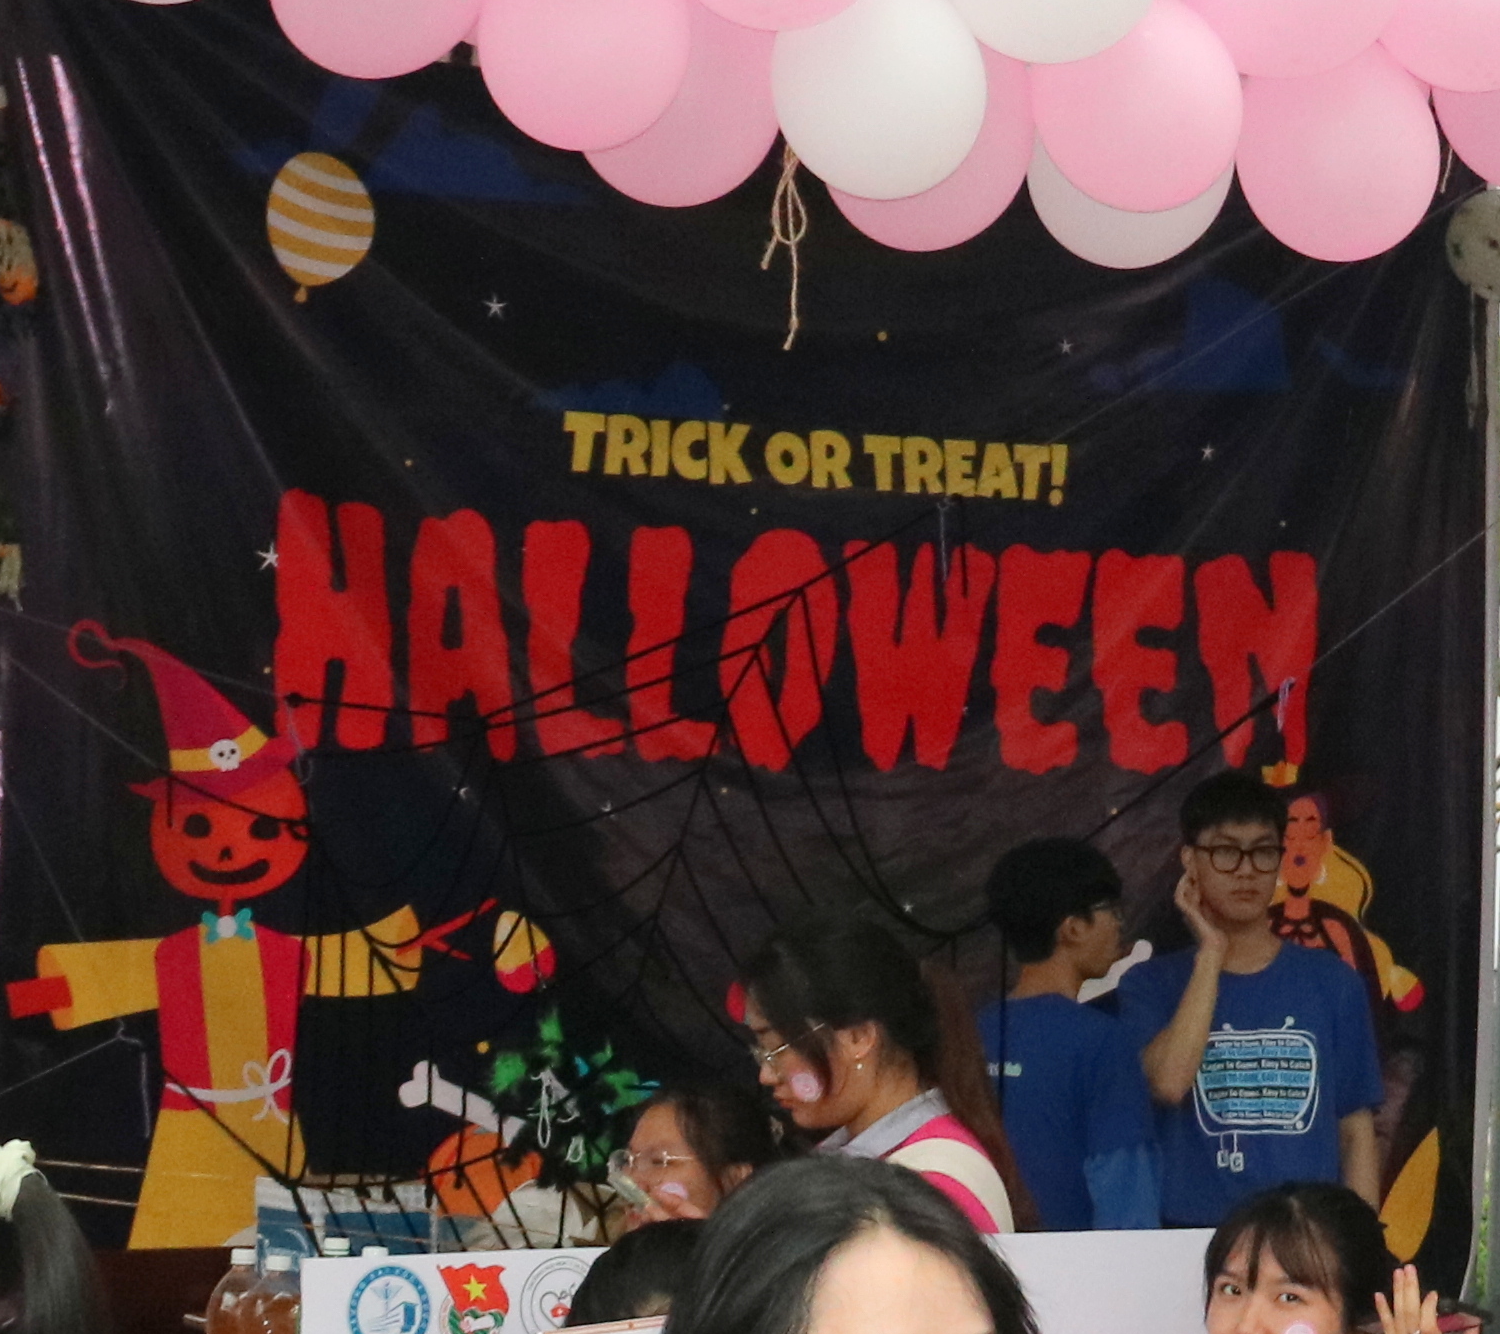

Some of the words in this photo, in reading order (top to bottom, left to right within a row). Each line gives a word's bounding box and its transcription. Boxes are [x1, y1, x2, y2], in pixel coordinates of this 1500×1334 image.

[560, 410, 751, 489] TRICK
[763, 425, 854, 492] OR
[860, 431, 1070, 508] TREAT!
[271, 486, 1321, 777] HALLOWEEN
